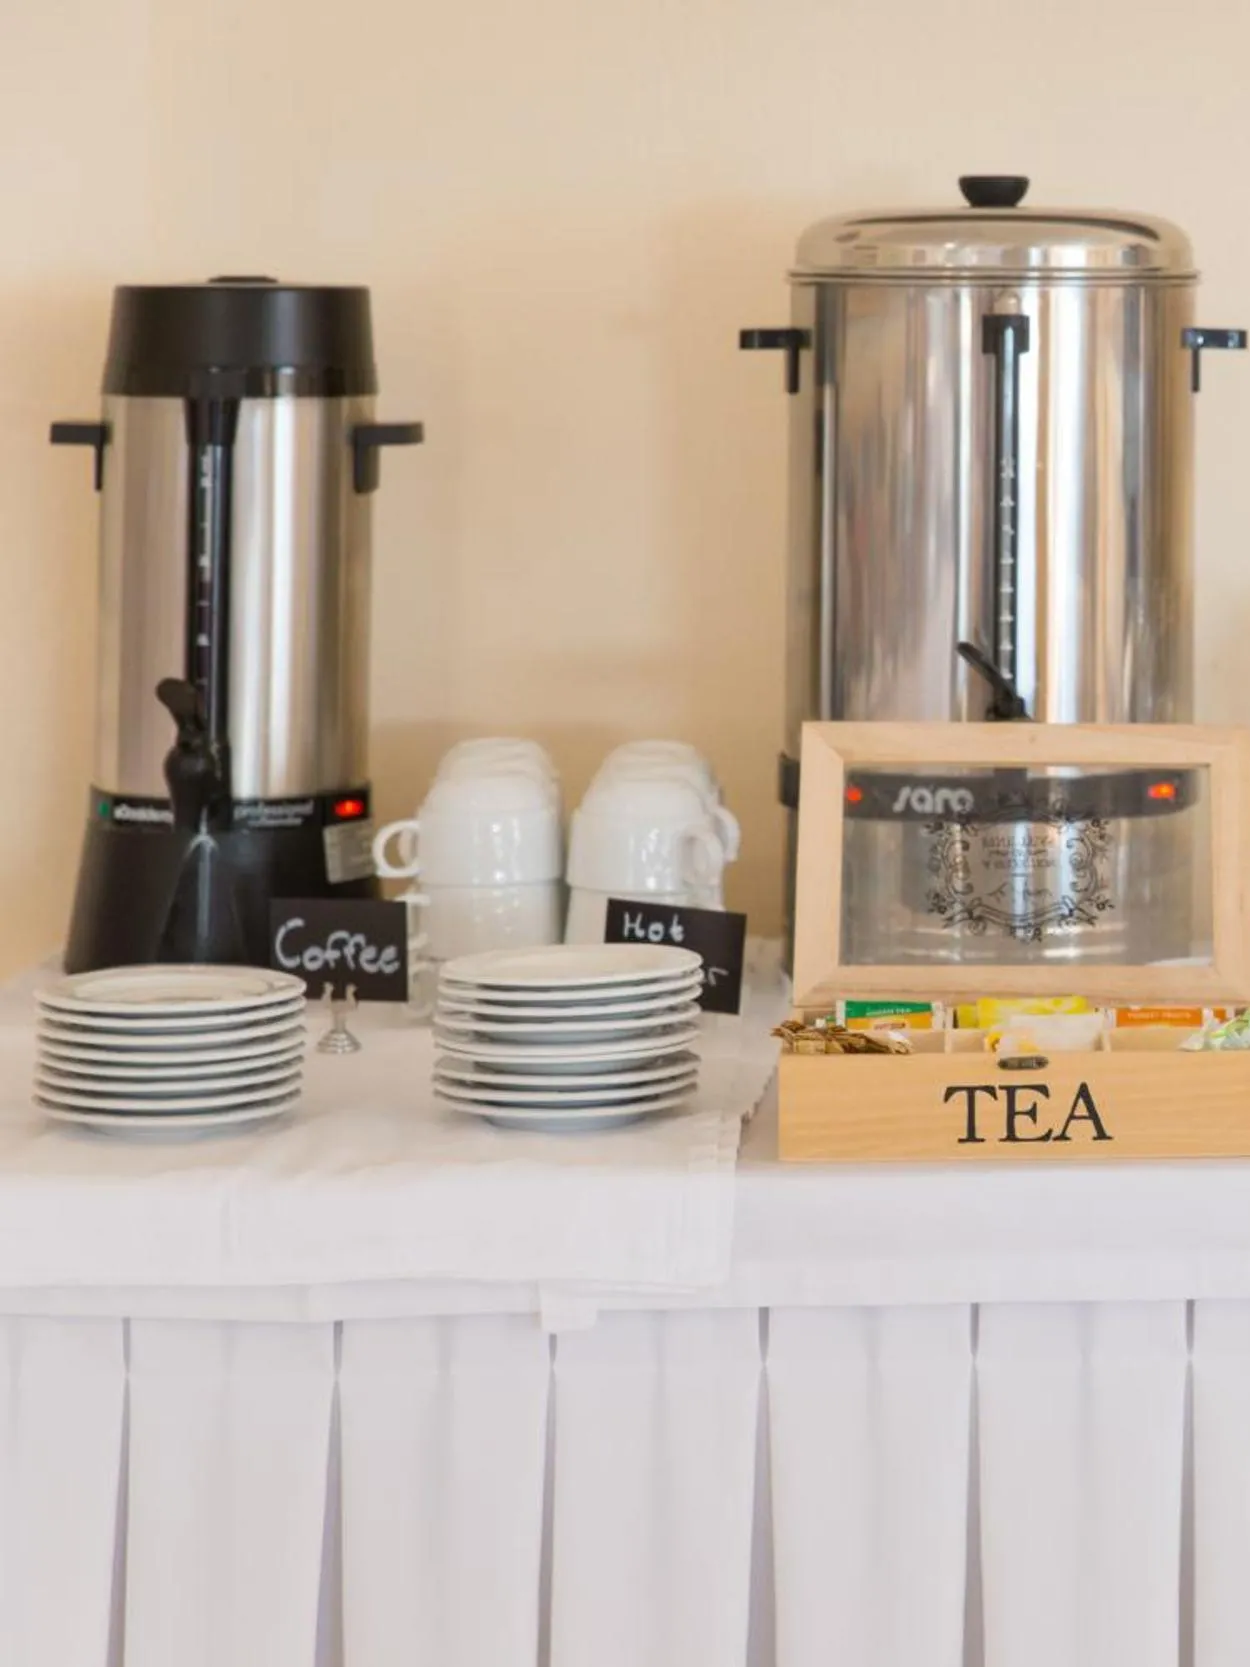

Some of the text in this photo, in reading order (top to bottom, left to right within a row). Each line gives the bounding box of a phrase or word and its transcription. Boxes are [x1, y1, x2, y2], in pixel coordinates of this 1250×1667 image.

[275, 917, 400, 974] Coffee
[623, 911, 685, 943] Hot
[943, 1082, 1114, 1144] TEA
